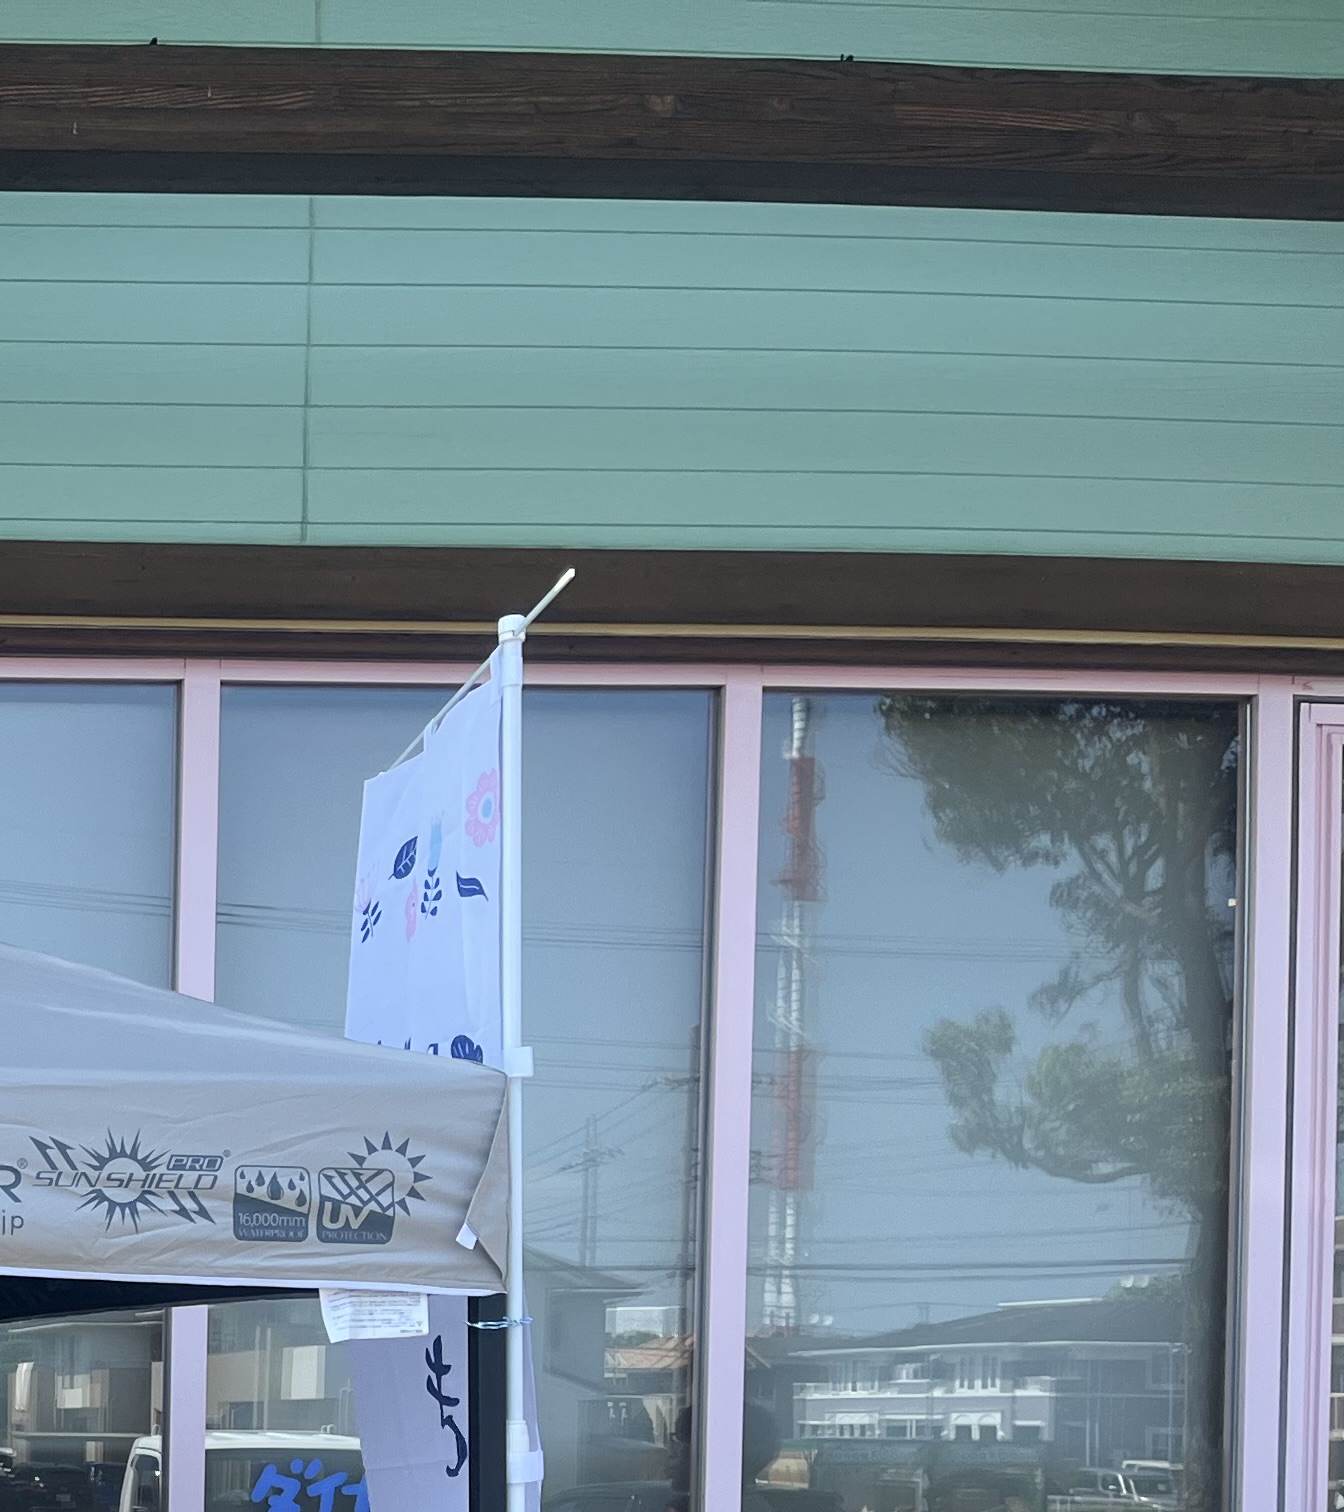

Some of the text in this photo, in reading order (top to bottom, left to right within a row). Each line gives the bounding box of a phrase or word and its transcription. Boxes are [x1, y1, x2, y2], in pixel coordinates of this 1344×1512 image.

[169, 1156, 221, 1171] PRO
[238, 1212, 306, 1227] 16,000mm
[322, 1201, 371, 1230] UV
[322, 1230, 389, 1241] PROTECTION
